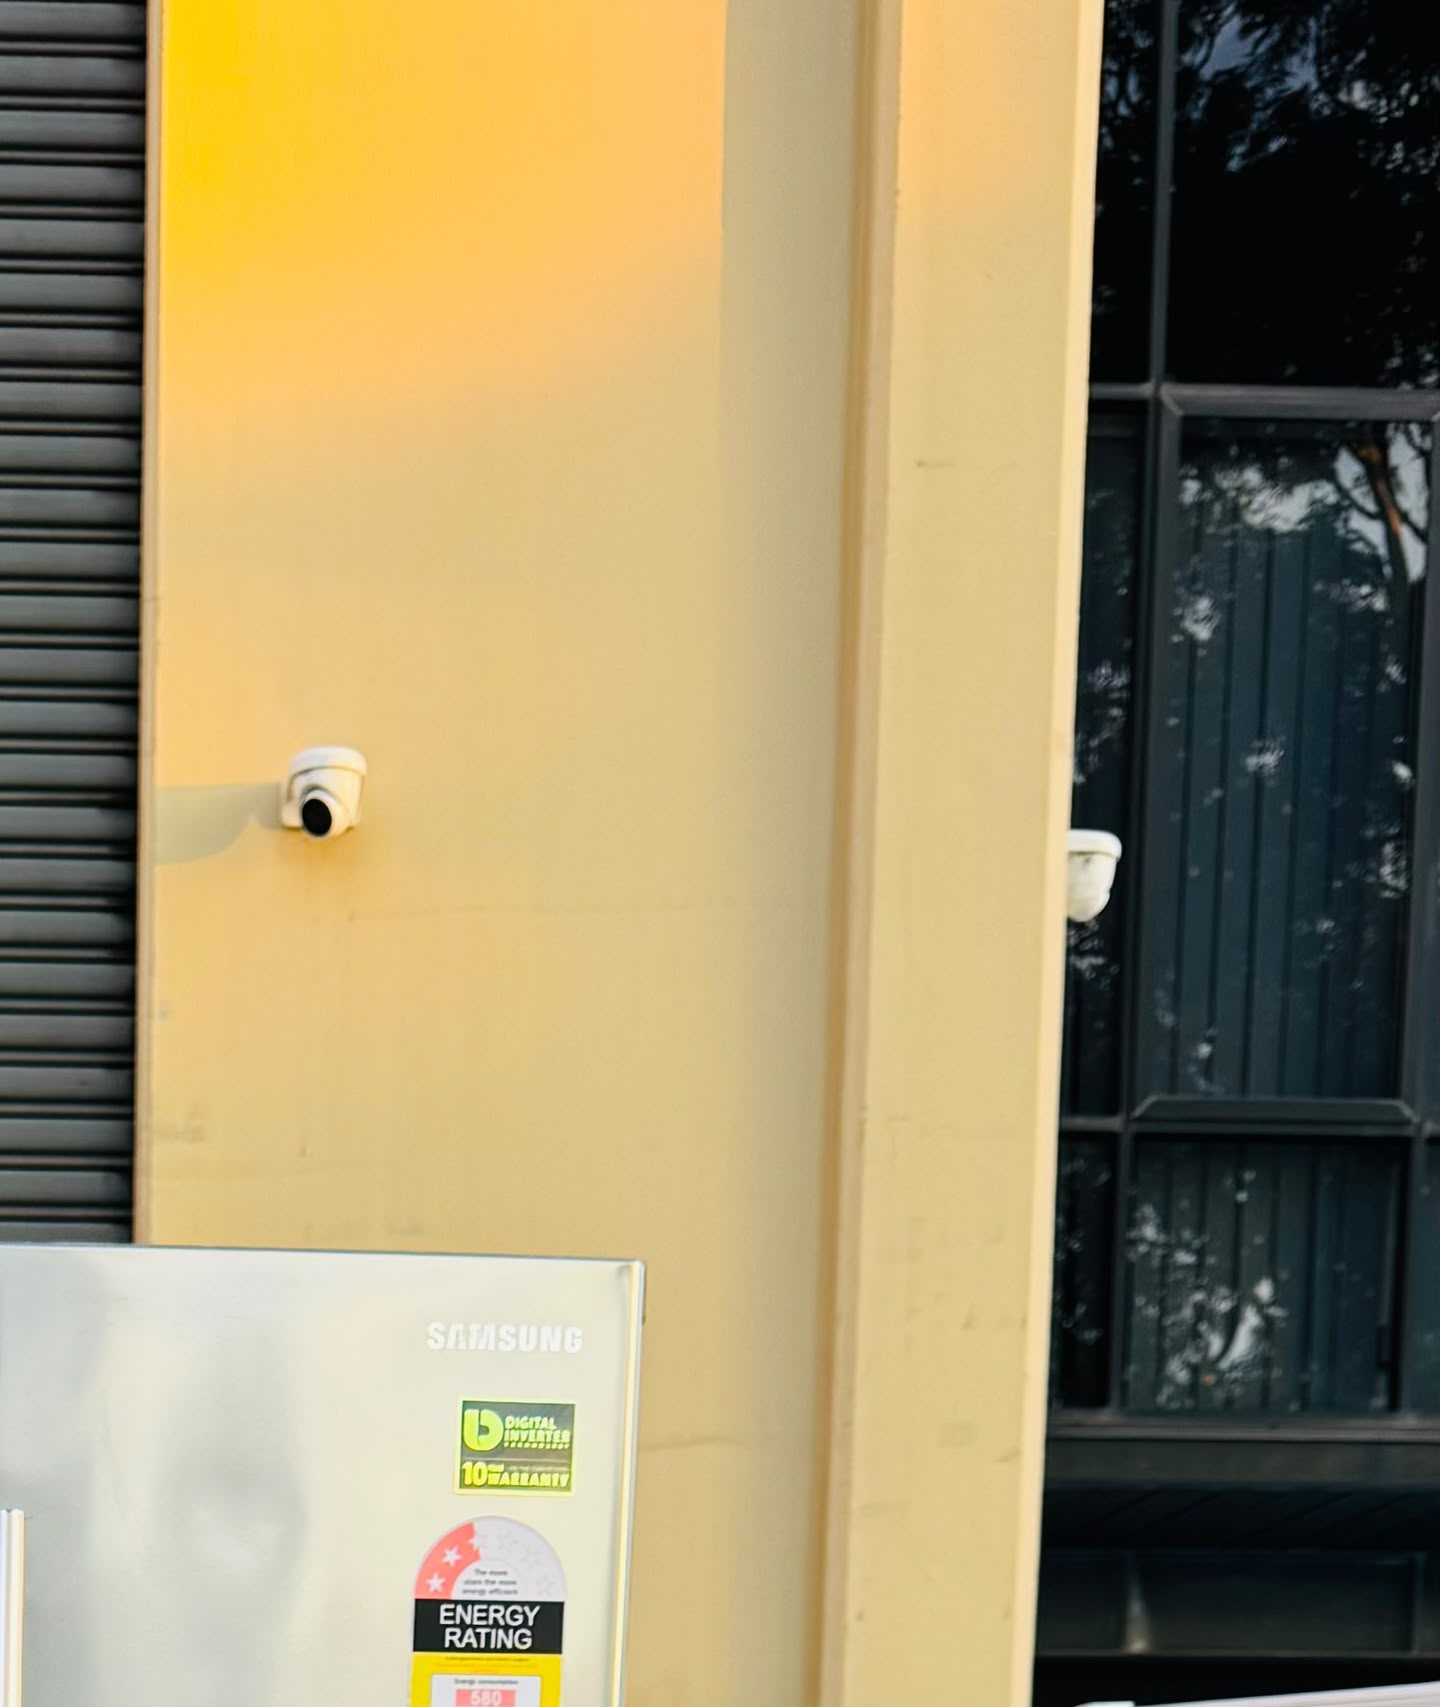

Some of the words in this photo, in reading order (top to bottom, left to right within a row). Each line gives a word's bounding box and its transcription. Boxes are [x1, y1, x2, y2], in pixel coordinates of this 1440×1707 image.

[427, 1321, 583, 1353] SAMSUNG
[505, 1415, 558, 1431] DIGITAL
[503, 1429, 570, 1443] INVERTER
[462, 1461, 488, 1486] 10
[440, 1603, 541, 1627] ENERGY
[444, 1627, 533, 1651] RATING
